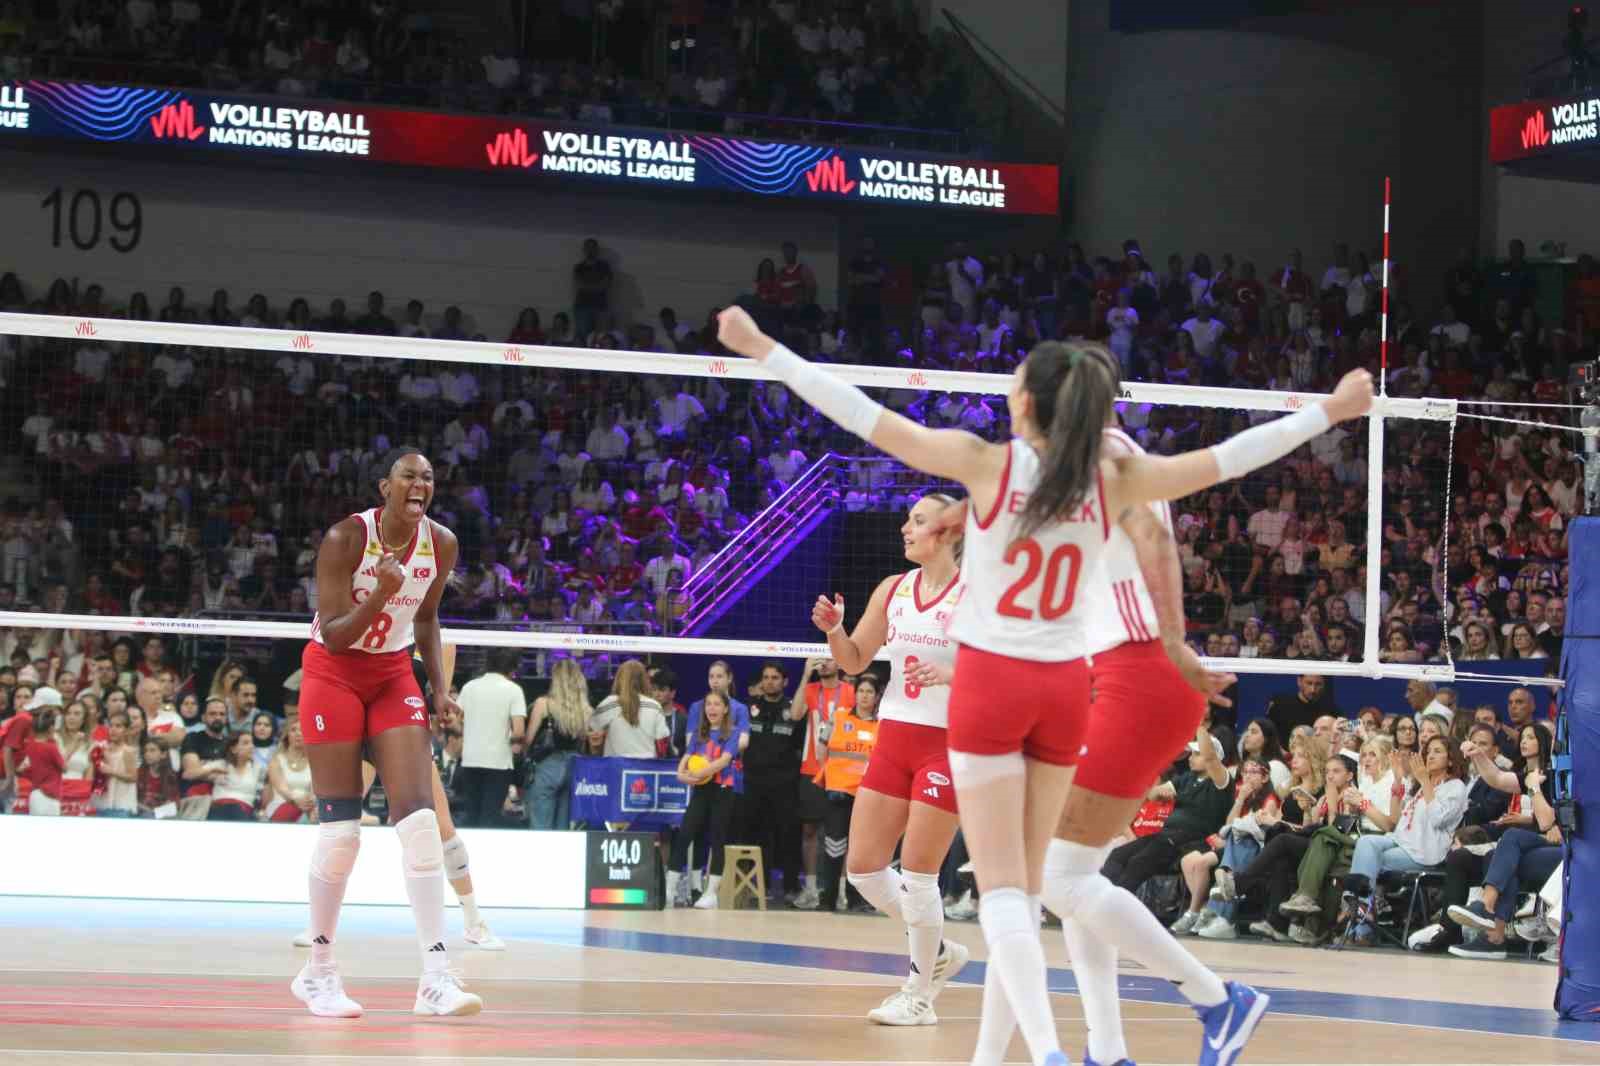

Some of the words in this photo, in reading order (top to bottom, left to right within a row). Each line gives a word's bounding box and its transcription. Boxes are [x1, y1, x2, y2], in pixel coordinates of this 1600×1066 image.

[209, 102, 371, 136] VOLLEYBALL
[209, 127, 293, 149] NATIONS
[297, 133, 370, 155] LEAGUE
[542, 130, 696, 164] VOLLEYBALL
[1551, 122, 1598, 145] NATIONS
[542, 153, 622, 176] NATIONS
[626, 161, 695, 182] LEAGUE
[860, 158, 1005, 190] VOLLEYBALL
[859, 180, 935, 202] NATIONS
[939, 187, 1005, 208] LEAGUE
[40, 187, 143, 253] 109
[995, 536, 1084, 622] 20
[363, 611, 393, 649] 8
[898, 632, 949, 648] vodafone
[315, 714, 326, 731] 8
[600, 839, 641, 865] 104.0
[609, 866, 631, 881] km/h
